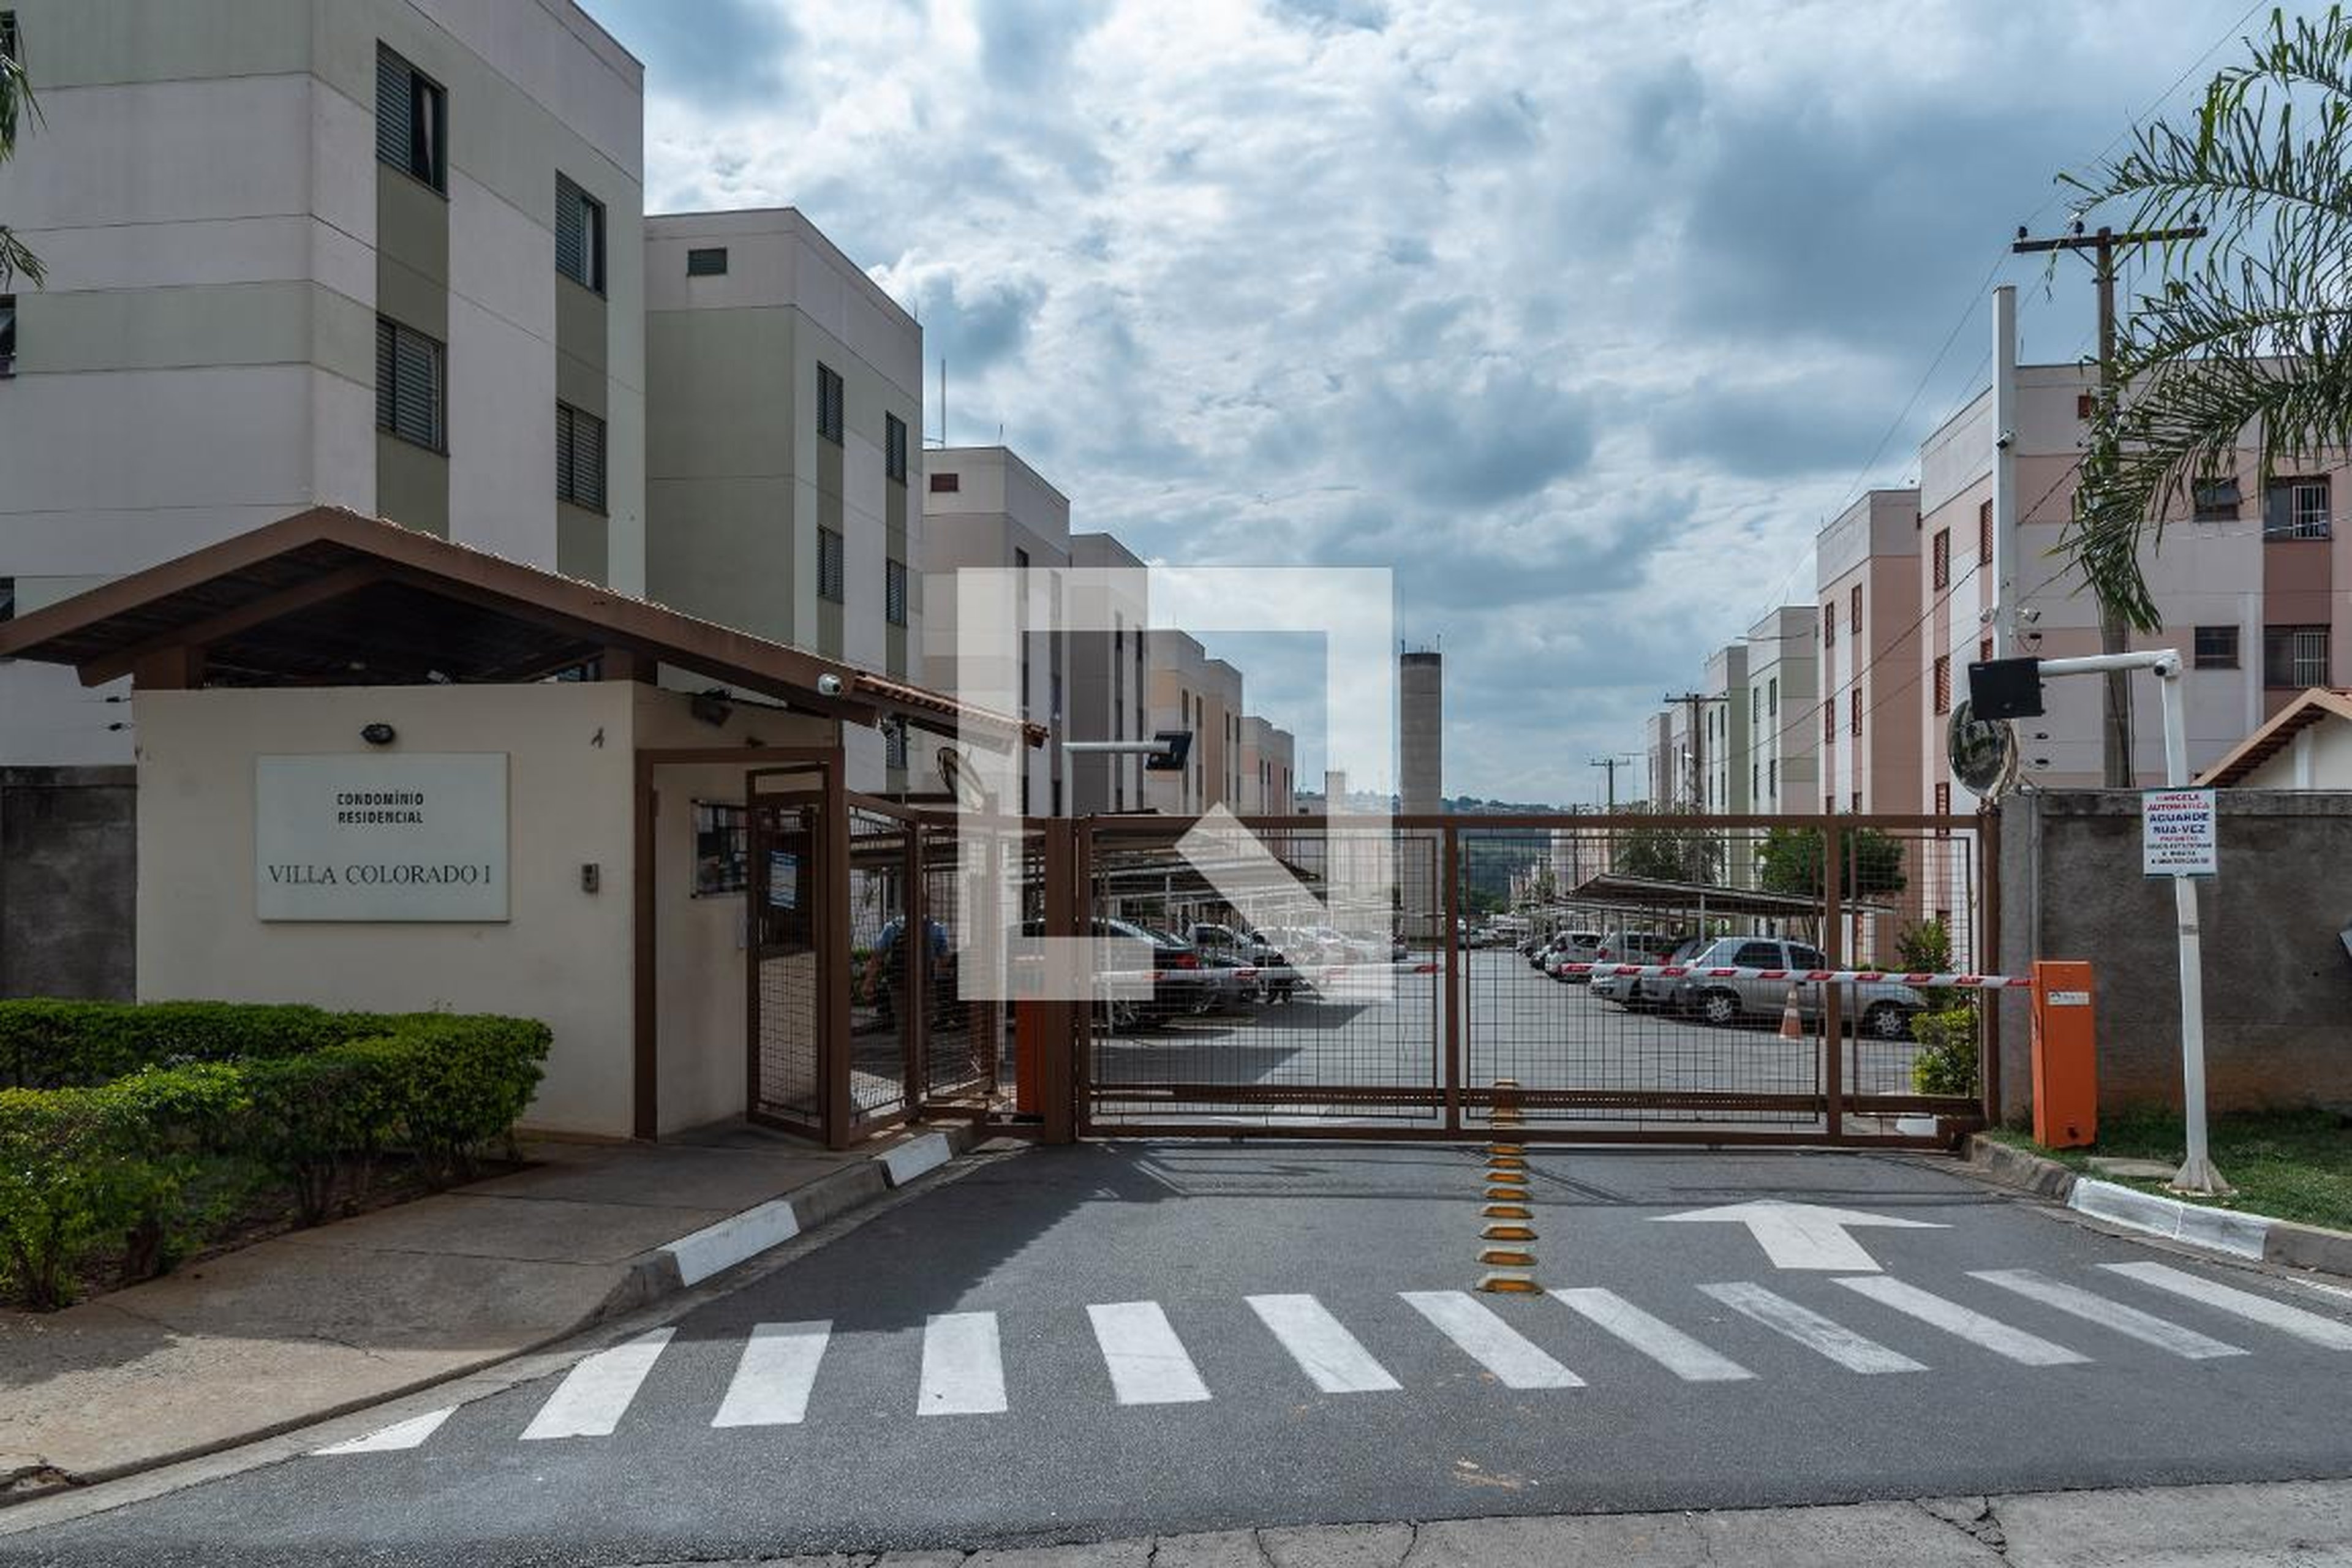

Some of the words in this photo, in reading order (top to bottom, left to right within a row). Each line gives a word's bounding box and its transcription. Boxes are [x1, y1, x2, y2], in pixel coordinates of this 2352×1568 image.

[337, 790, 424, 805] CONDOMÍNIO
[338, 811, 424, 824] RESIDENCIAL
[268, 865, 337, 884] VILLA
[345, 865, 478, 885] COLORADO
[484, 865, 491, 884] I
